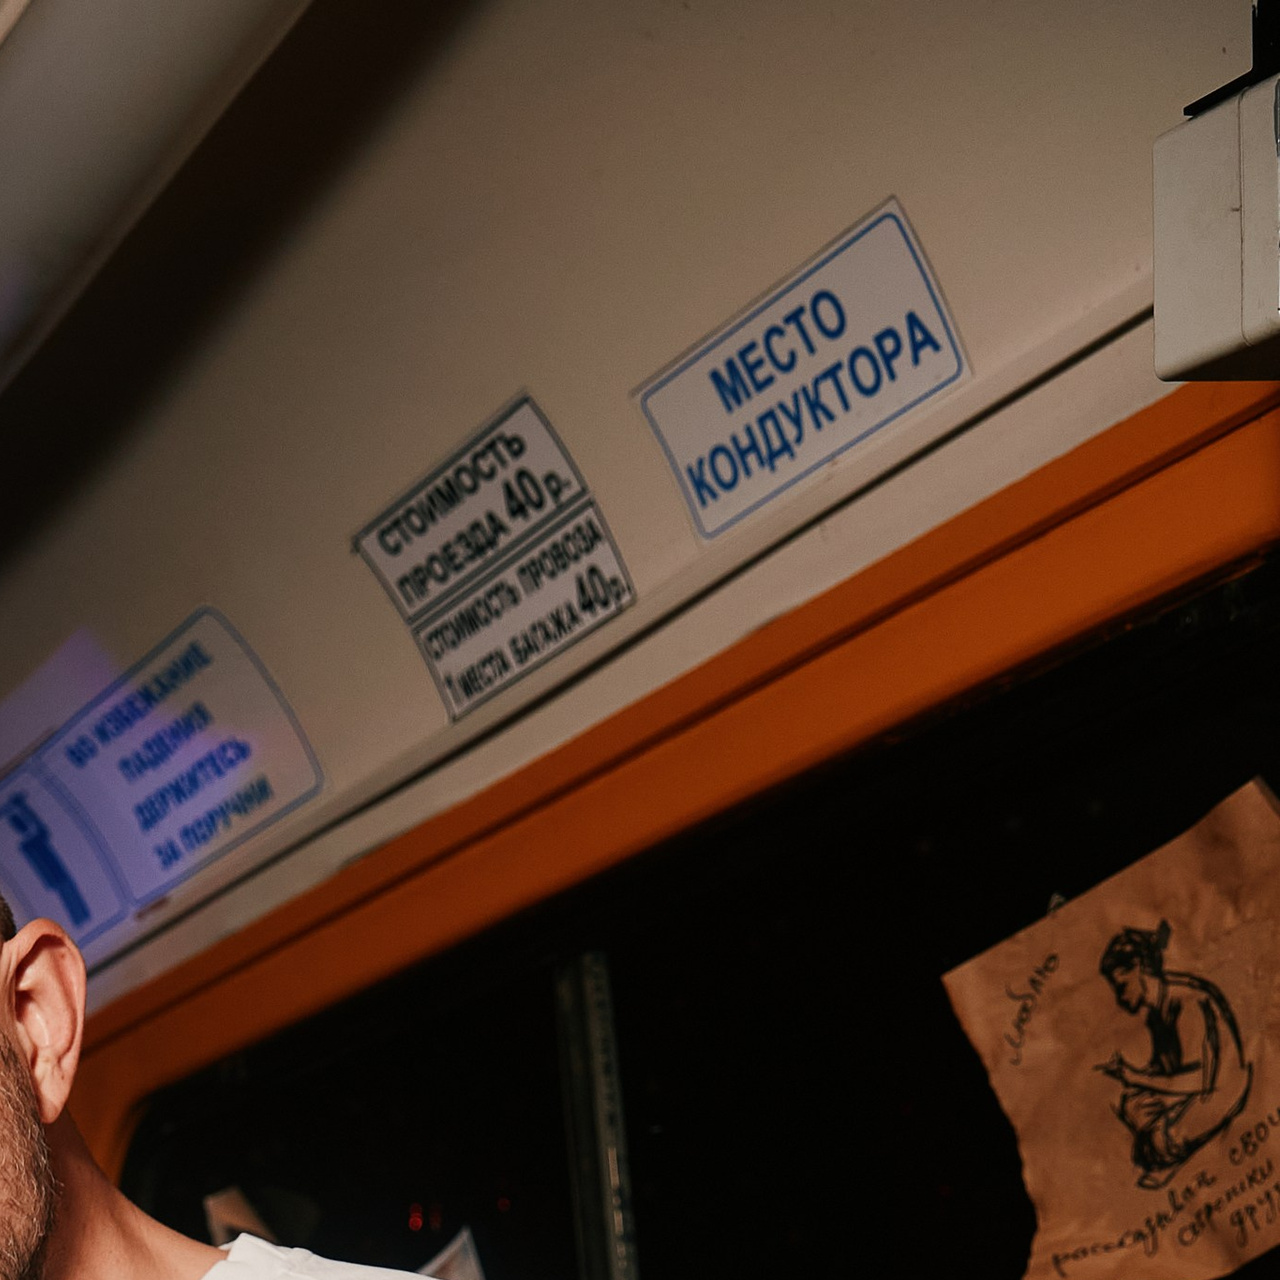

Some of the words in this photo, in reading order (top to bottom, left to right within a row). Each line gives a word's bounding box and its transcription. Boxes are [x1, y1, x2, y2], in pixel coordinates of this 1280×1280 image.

[686, 311, 941, 508] КОНДУКТОРА
[709, 289, 847, 413] МЕСТО
[377, 432, 527, 556] СТОИМОСТЬ
[397, 511, 511, 607] ПРОЕЗДА
[424, 579, 520, 661] СТОИМОСТЬ
[517, 518, 603, 596] ПРОВОЗА
[457, 648, 513, 698] МЕСТА
[508, 606, 580, 665] БАГАЖА
[133, 735, 251, 834] ДЕРЖИТЕСЬ
